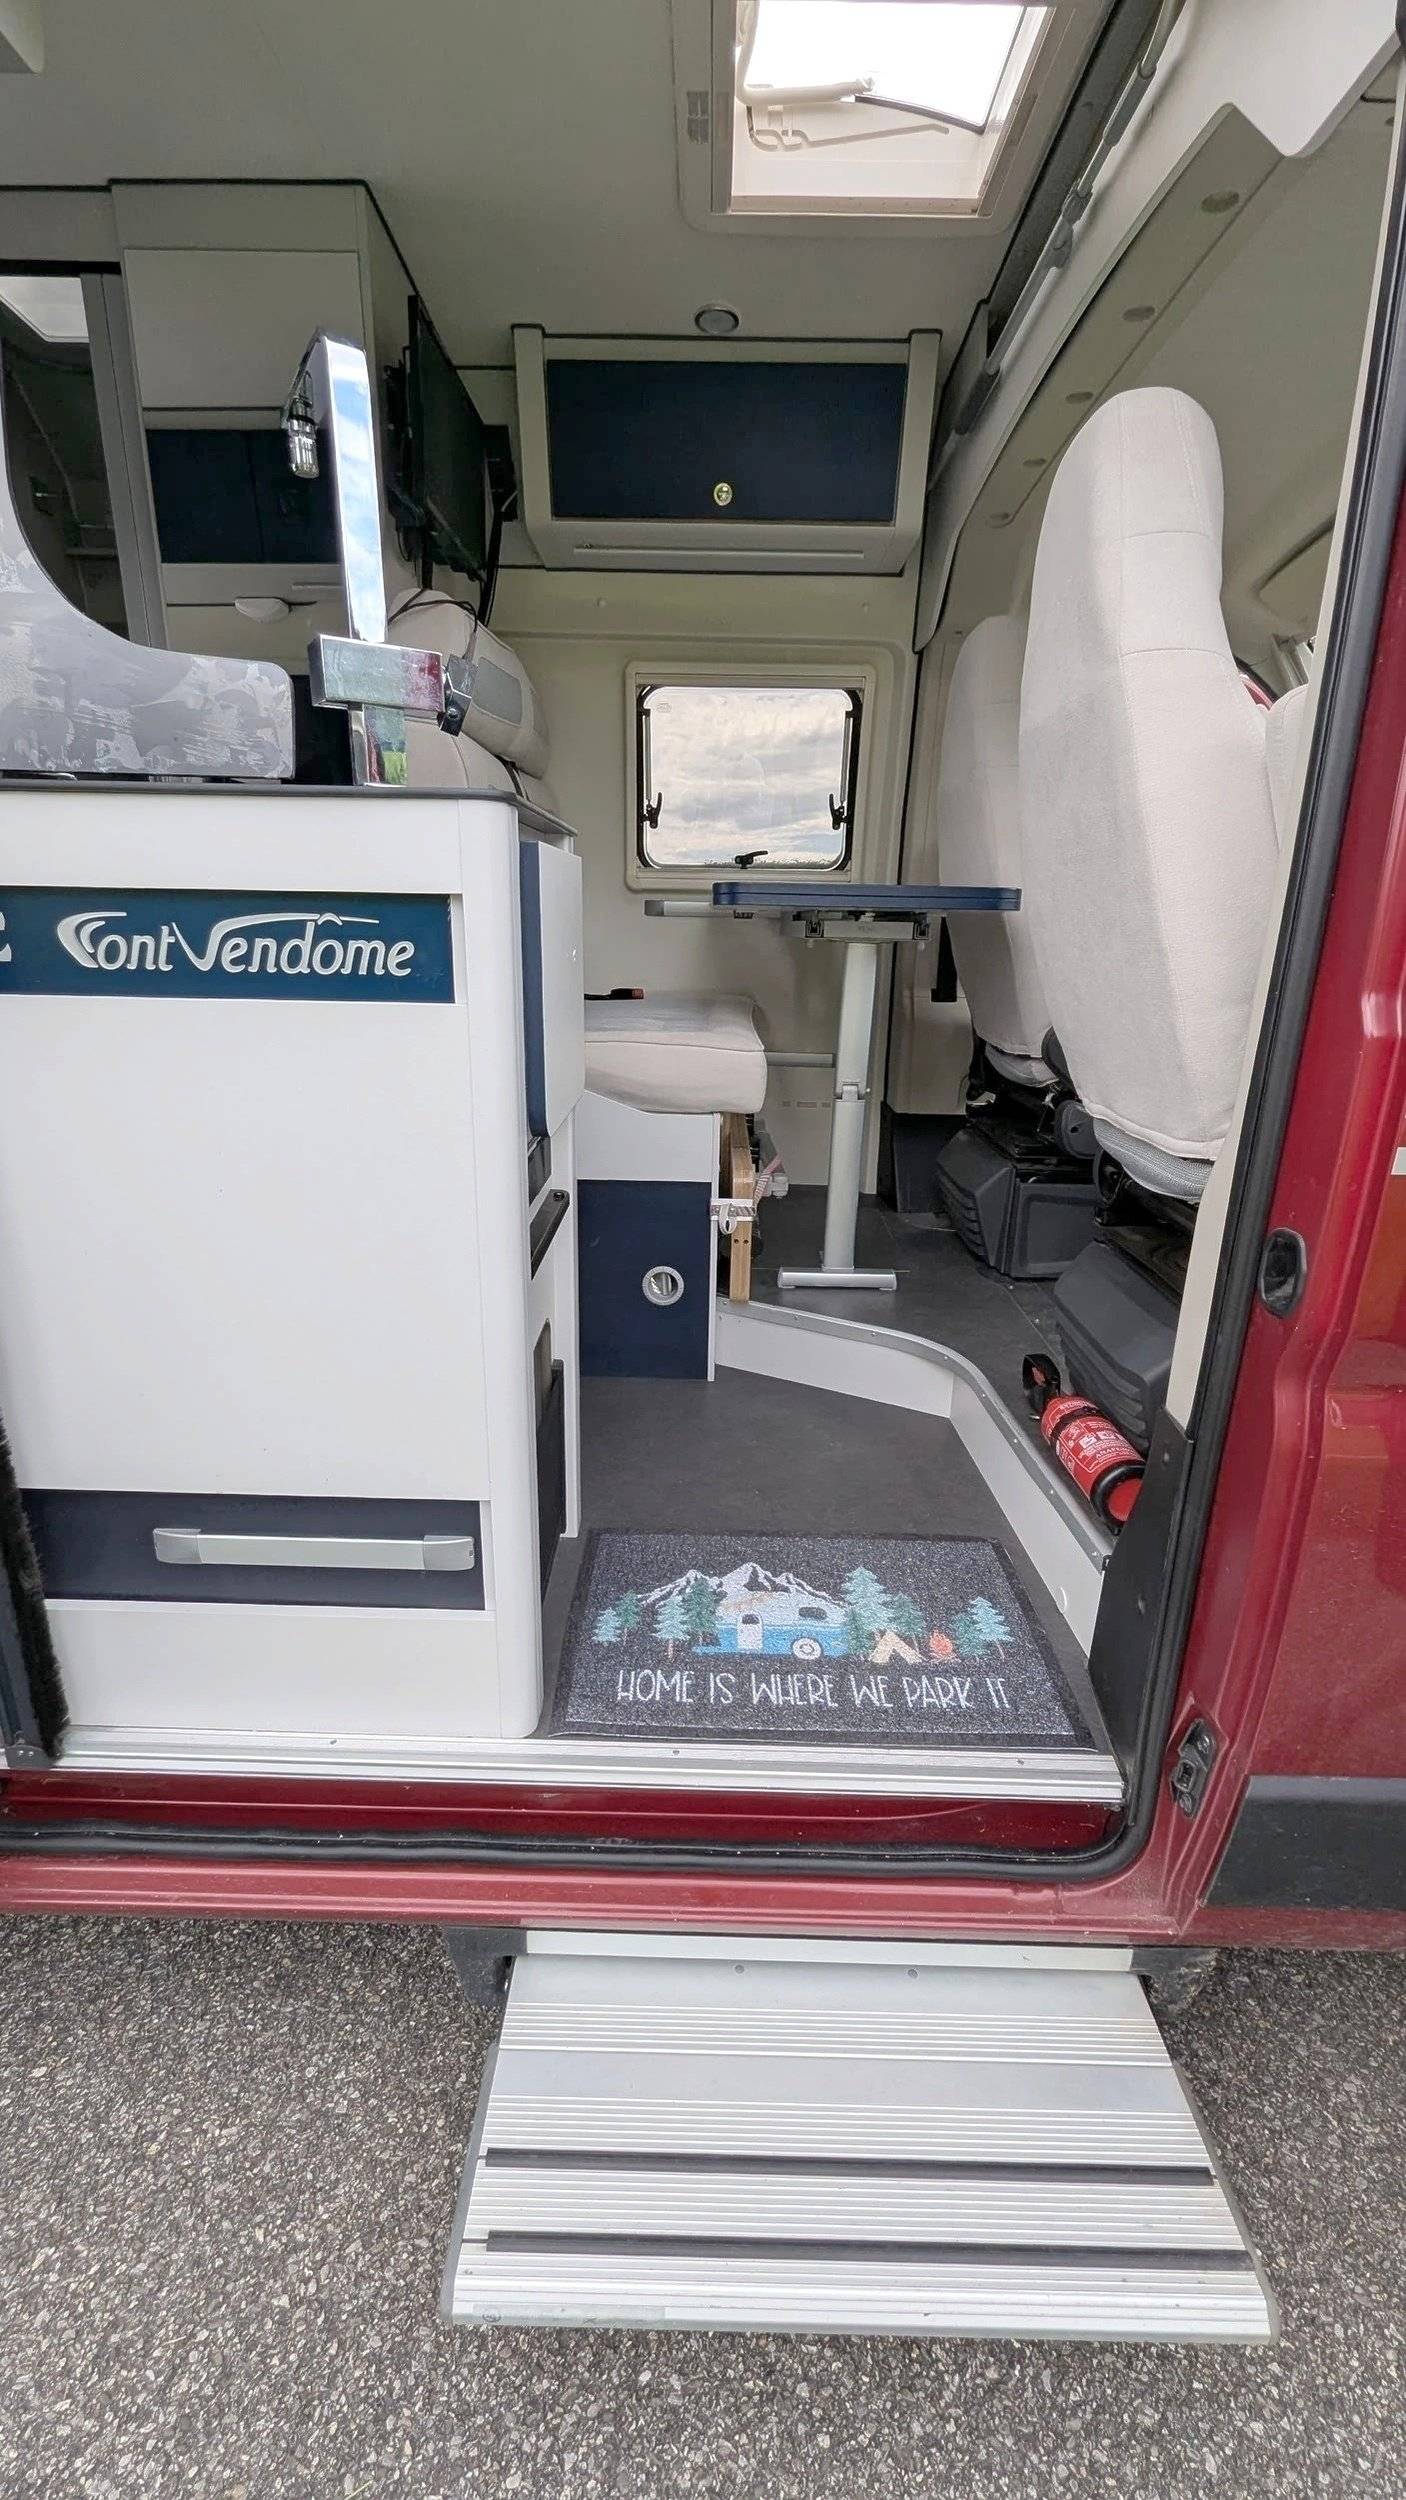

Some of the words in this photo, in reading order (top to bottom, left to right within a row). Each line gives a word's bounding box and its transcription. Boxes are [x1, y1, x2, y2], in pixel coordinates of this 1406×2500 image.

[617, 1669, 696, 1702] HOME
[709, 1672, 736, 1704] IS
[751, 1672, 839, 1707] WHERE
[850, 1674, 894, 1708] WE
[902, 1674, 975, 1709] PARK
[985, 1677, 1011, 1709] IT
